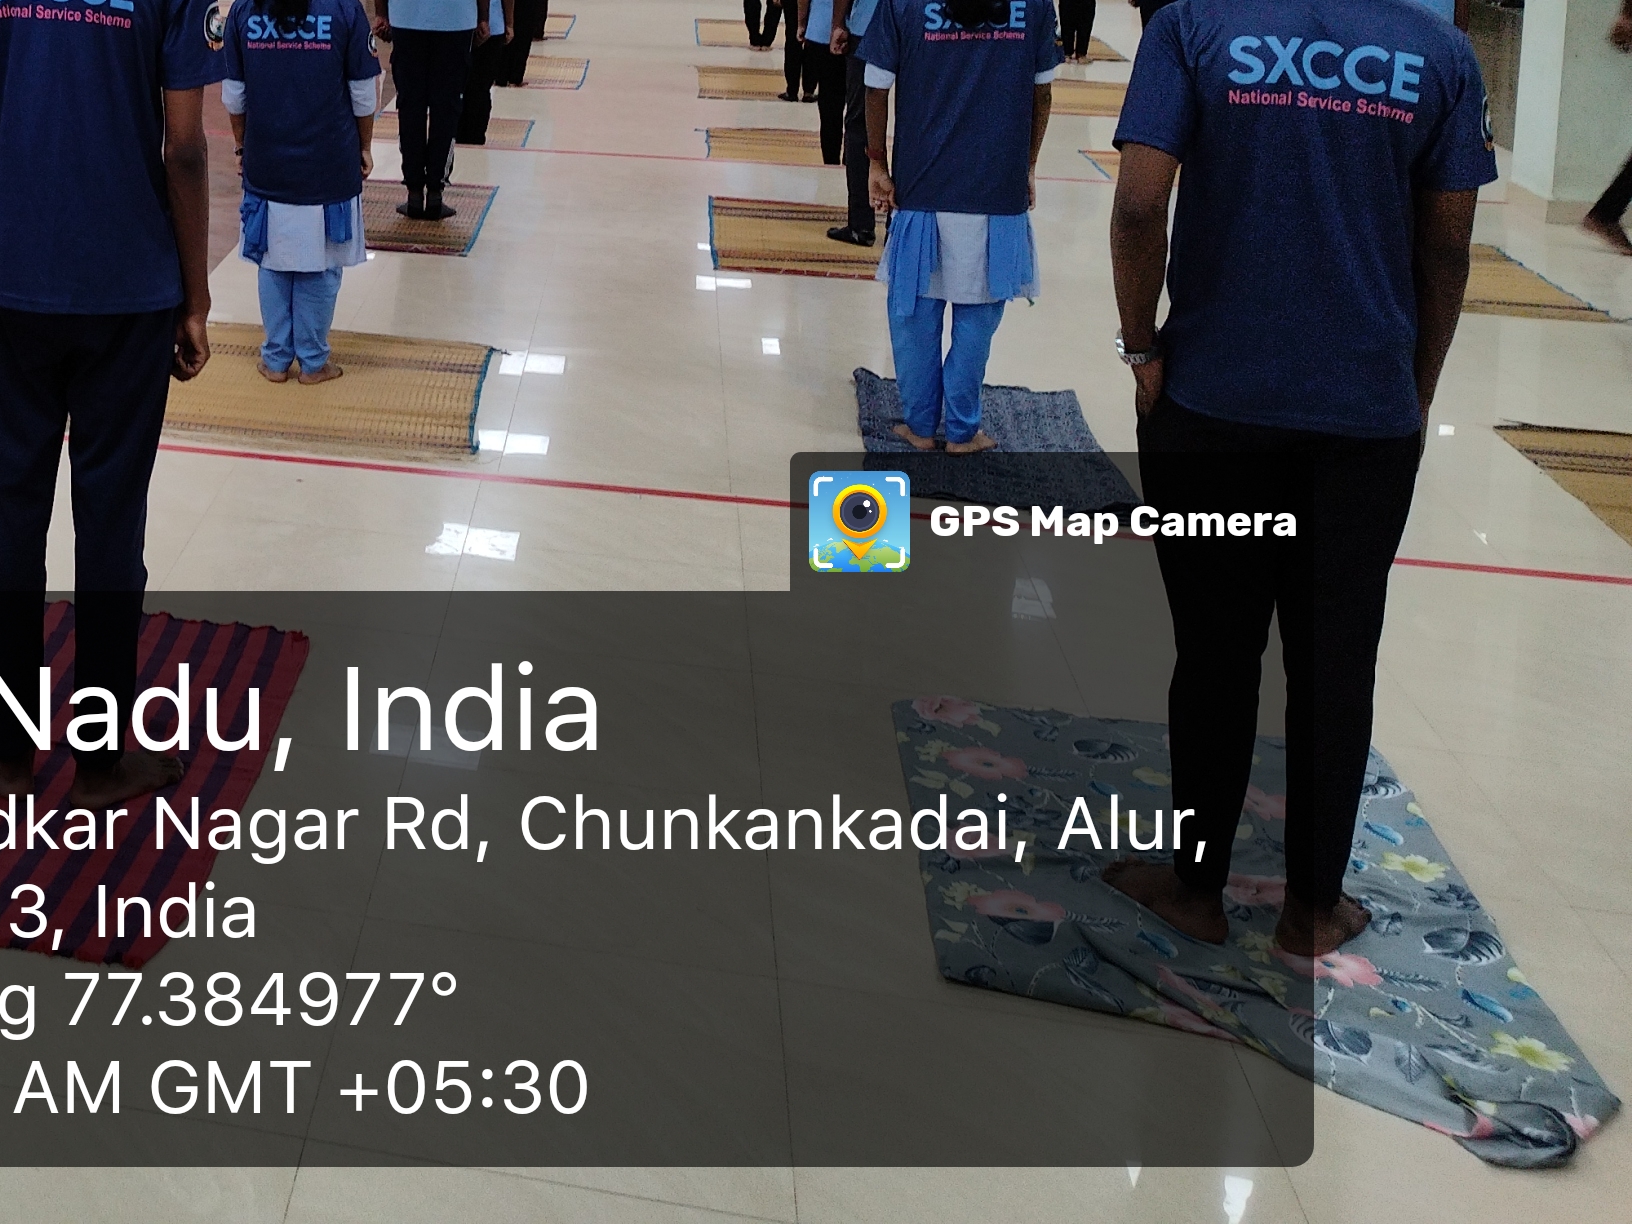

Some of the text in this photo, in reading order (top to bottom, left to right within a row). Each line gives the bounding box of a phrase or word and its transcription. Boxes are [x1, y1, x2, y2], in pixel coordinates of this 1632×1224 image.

[35, 5, 81, 22] Service
[84, 8, 132, 29] Scheme
[277, 40, 302, 50] Service
[303, 40, 332, 51] Scheme
[1228, 35, 1425, 104] SXCCE
[1228, 88, 1292, 106] National
[1296, 91, 1351, 113] Service
